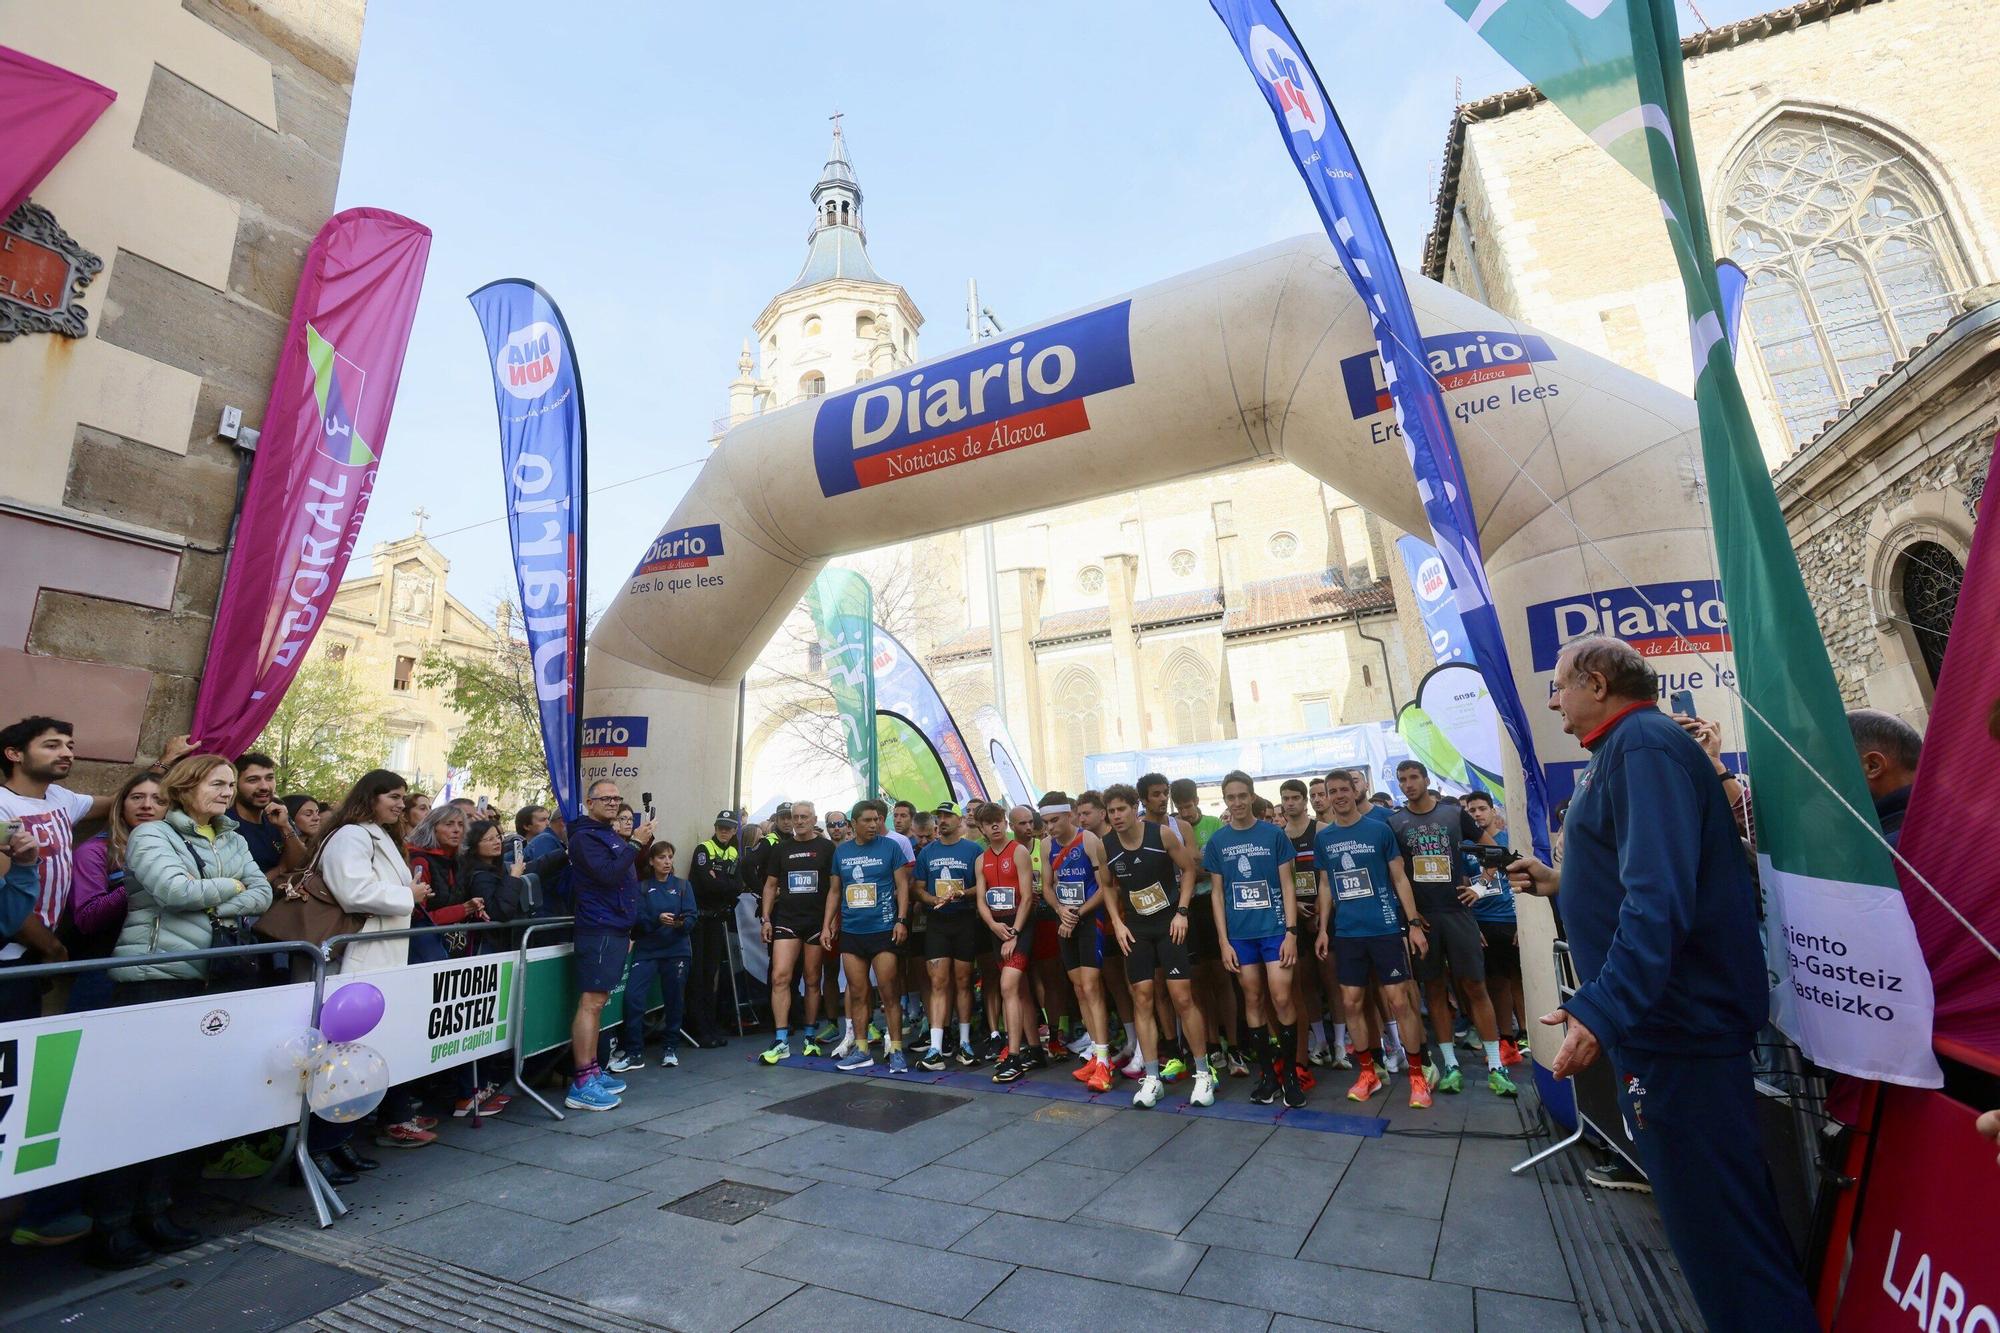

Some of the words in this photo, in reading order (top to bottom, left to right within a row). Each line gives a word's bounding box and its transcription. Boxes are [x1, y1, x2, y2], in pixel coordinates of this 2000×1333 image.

[1449, 376, 1464, 389] de
[1468, 369, 1506, 387] Álava
[851, 340, 1077, 451] Diario
[1370, 421, 1403, 444] Ere
[1454, 395, 1501, 424] que
[1511, 384, 1560, 405] lees
[887, 447, 957, 479] Noticias
[962, 436, 984, 458] de
[987, 421, 1047, 451] Álava
[643, 532, 706, 564] Diario
[630, 581, 651, 595] Eres
[653, 578, 664, 592] lo
[668, 578, 692, 594] que
[697, 574, 724, 588] lees
[1554, 588, 1727, 646] Diario
[1645, 642, 1662, 655] de
[1666, 635, 1711, 654] Álava
[589, 766, 607, 780] que
[611, 763, 639, 777] lees
[794, 876, 812, 885] 1078
[1342, 877, 1361, 889] 973
[853, 889, 868, 899] 519
[1139, 893, 1156, 907] 701
[1241, 888, 1260, 900] 825
[432, 963, 498, 1004] VITORIA
[428, 995, 497, 1040] GASTEIZ
[430, 1039, 460, 1063] green
[461, 1027, 493, 1052] capital
